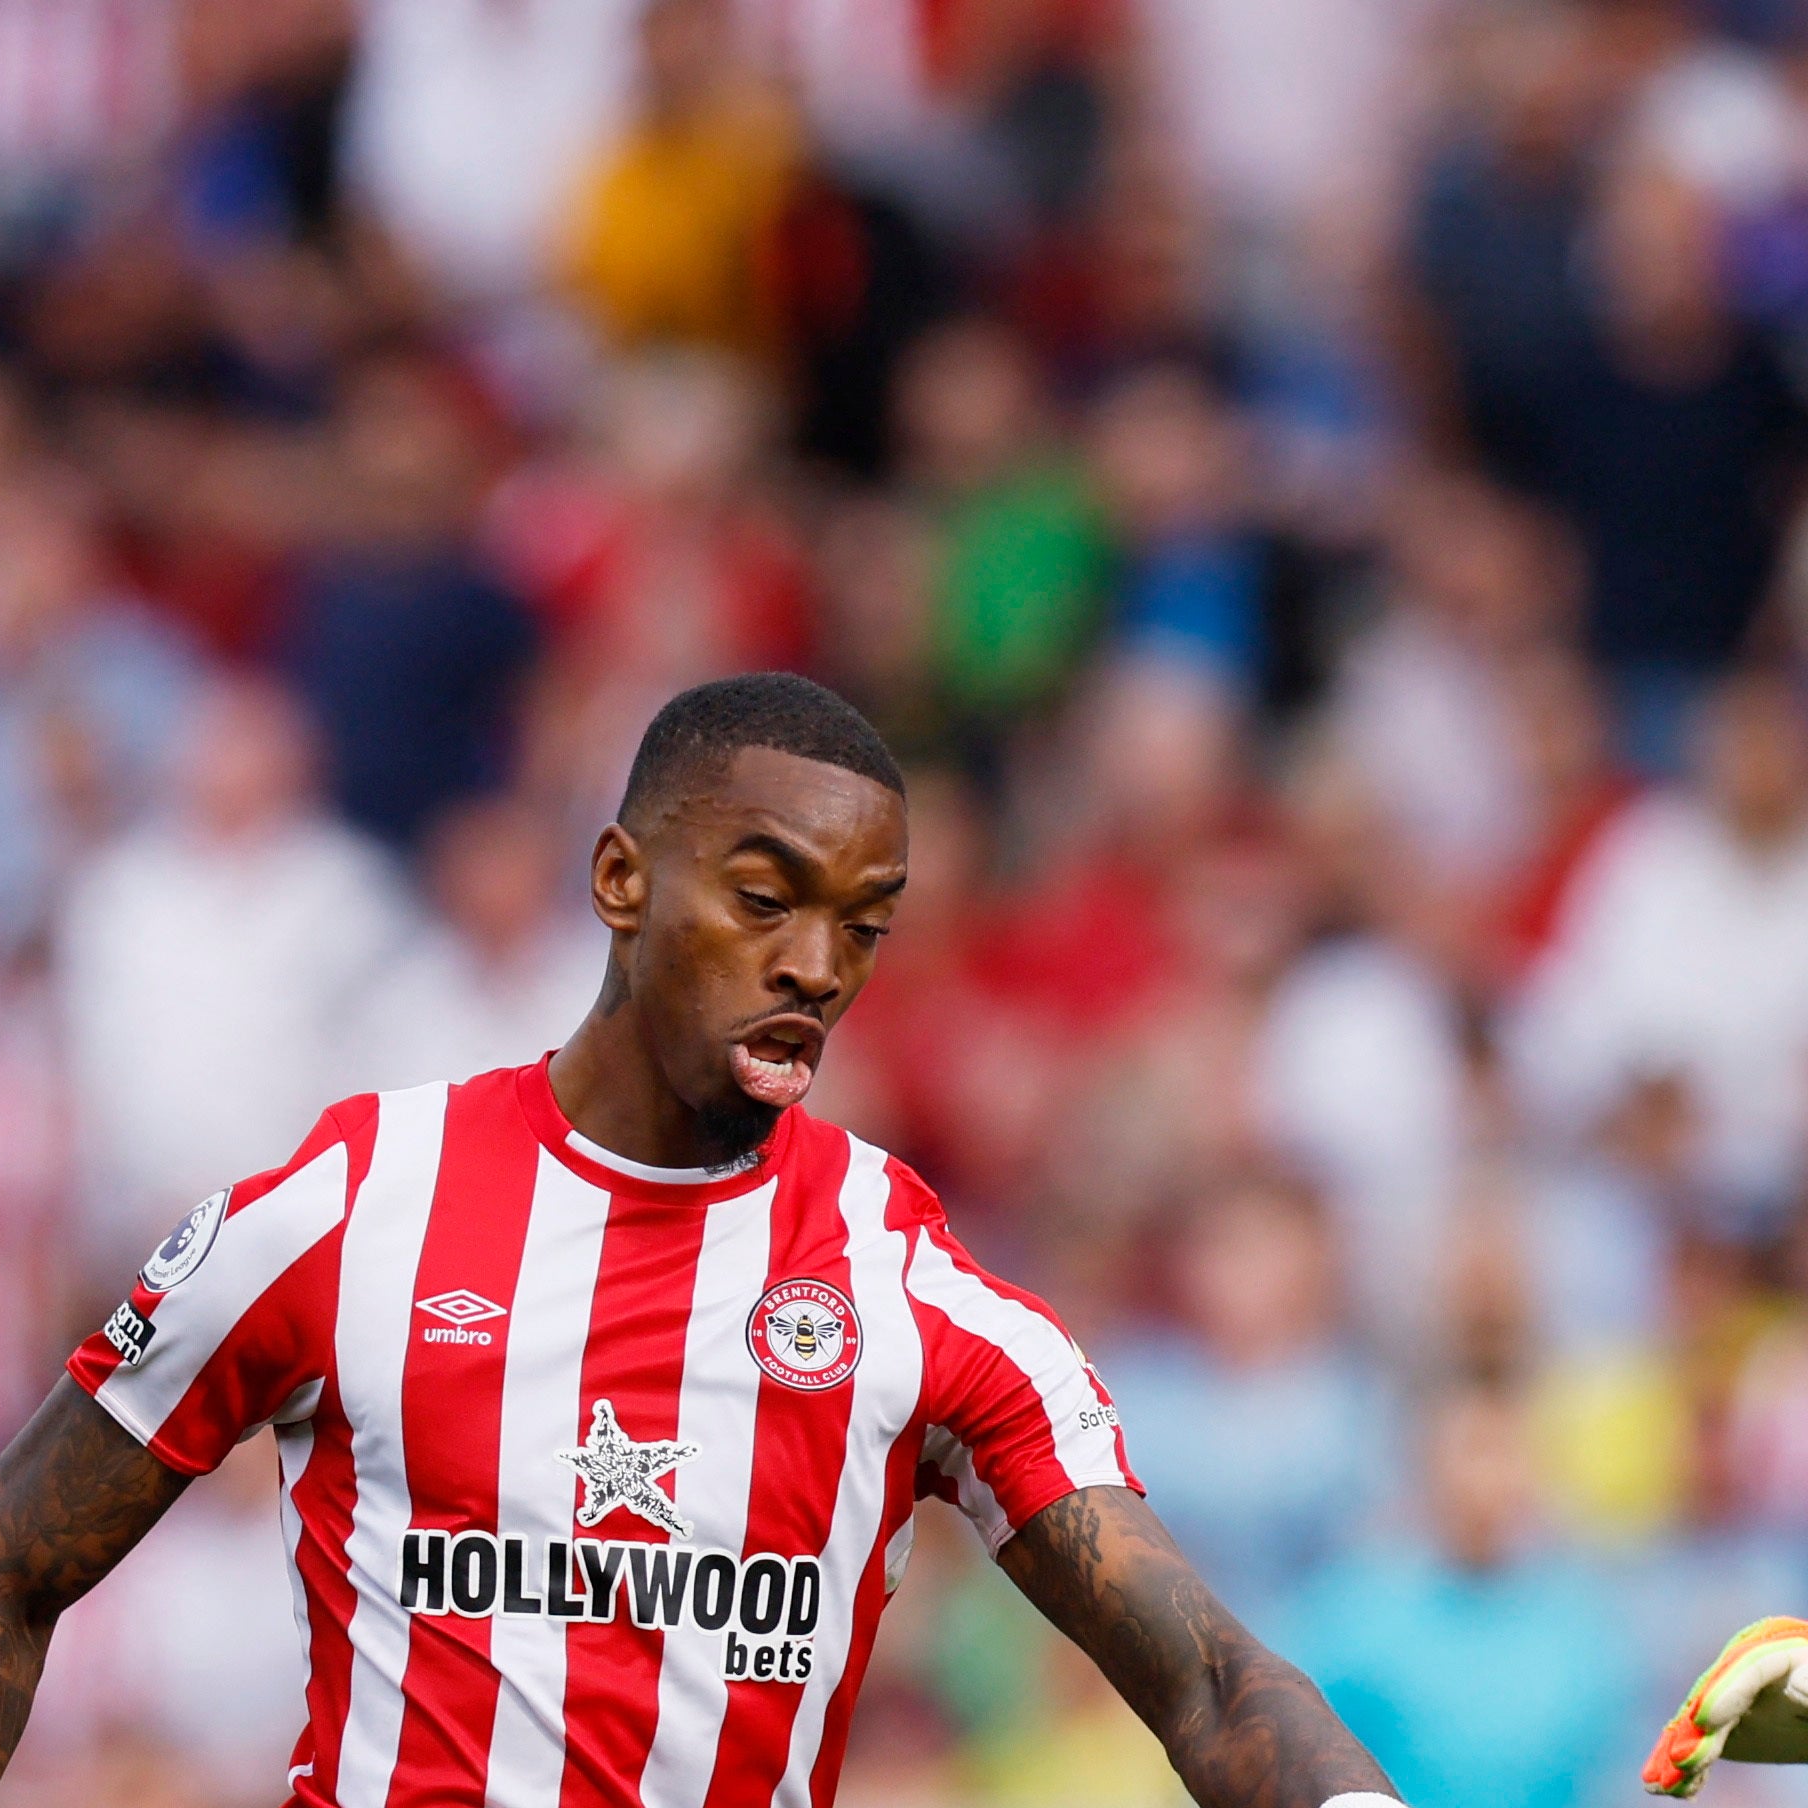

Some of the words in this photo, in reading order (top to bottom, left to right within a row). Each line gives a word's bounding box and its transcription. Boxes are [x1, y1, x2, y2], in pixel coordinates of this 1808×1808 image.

[170, 1247, 197, 1276] League
[763, 1286, 846, 1316] BRENTFORD
[424, 1326, 492, 1346] umbro
[752, 1328, 763, 1338] 18
[763, 1356, 821, 1385] FOOTBALL
[822, 1362, 848, 1380] CLUB
[1079, 1405, 1117, 1430] Safe
[400, 1533, 820, 1637] HOLLYWOOD
[725, 1631, 813, 1678] bets
